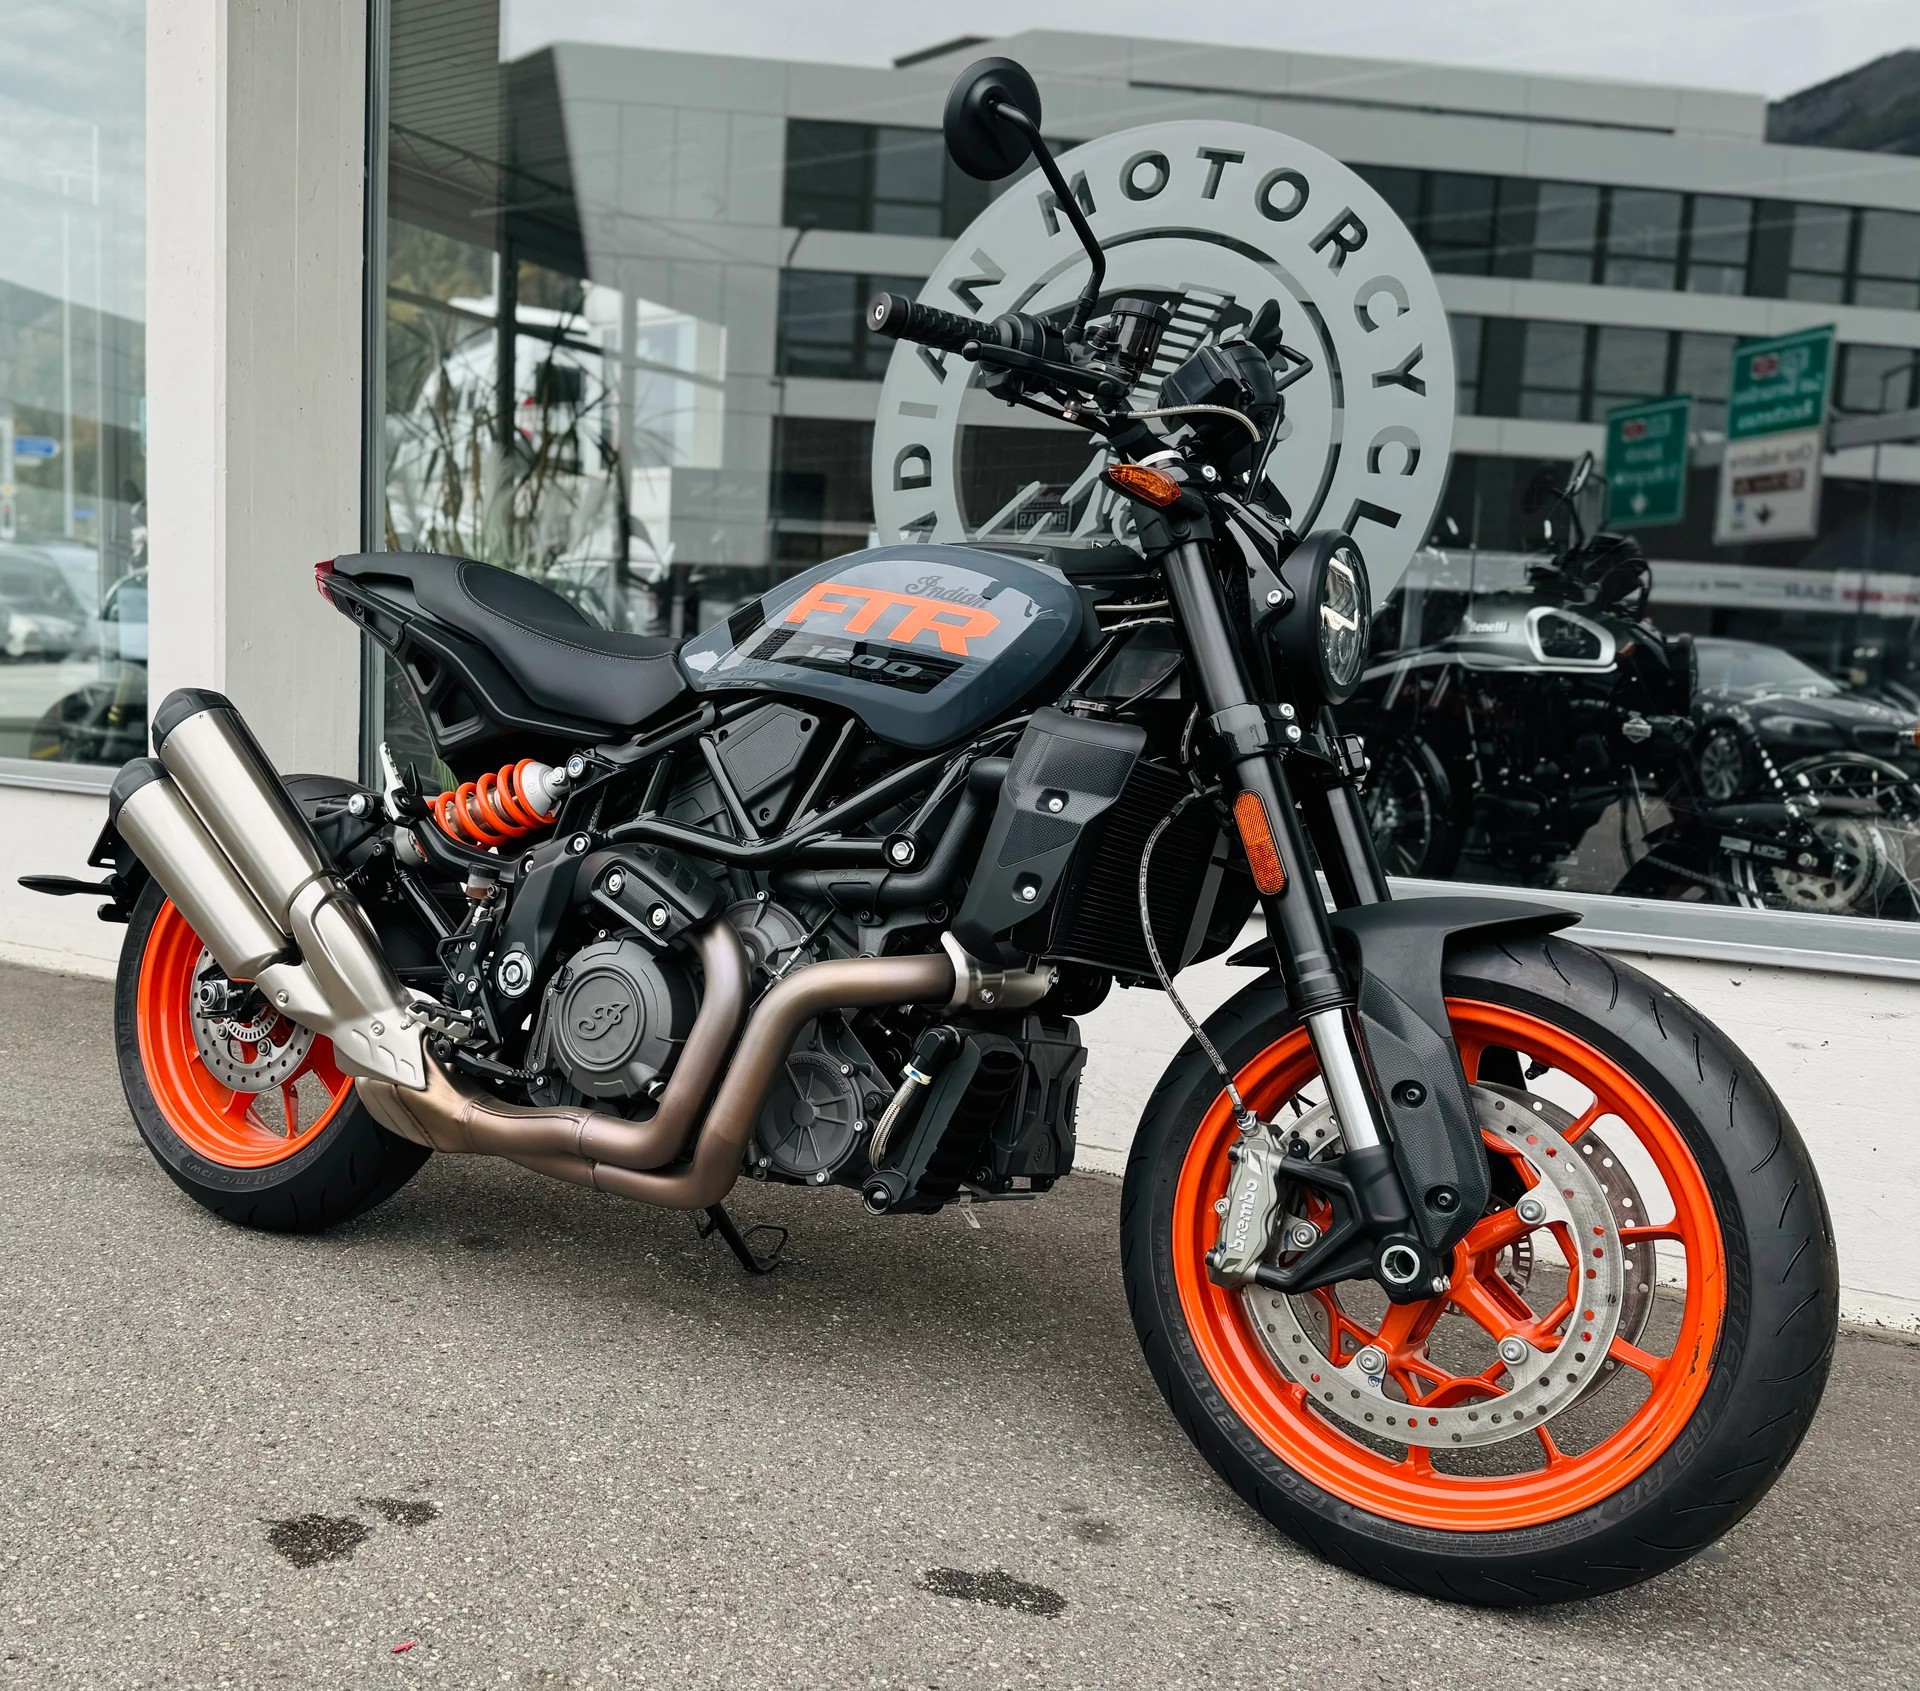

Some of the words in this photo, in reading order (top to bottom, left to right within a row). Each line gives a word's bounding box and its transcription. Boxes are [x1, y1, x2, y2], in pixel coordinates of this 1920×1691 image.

[1036, 146, 1428, 536] MOTORCYCL
[1019, 512, 1067, 526] RACNG
[784, 582, 1000, 657] FTR
[904, 575, 991, 608] Indian
[1469, 620, 1509, 633] Benelli
[800, 644, 924, 679] 1200
[1228, 1178, 1260, 1253] brembo
[1712, 1190, 1751, 1402] SPORTEC
[1236, 1435, 1329, 1510] 120/70
